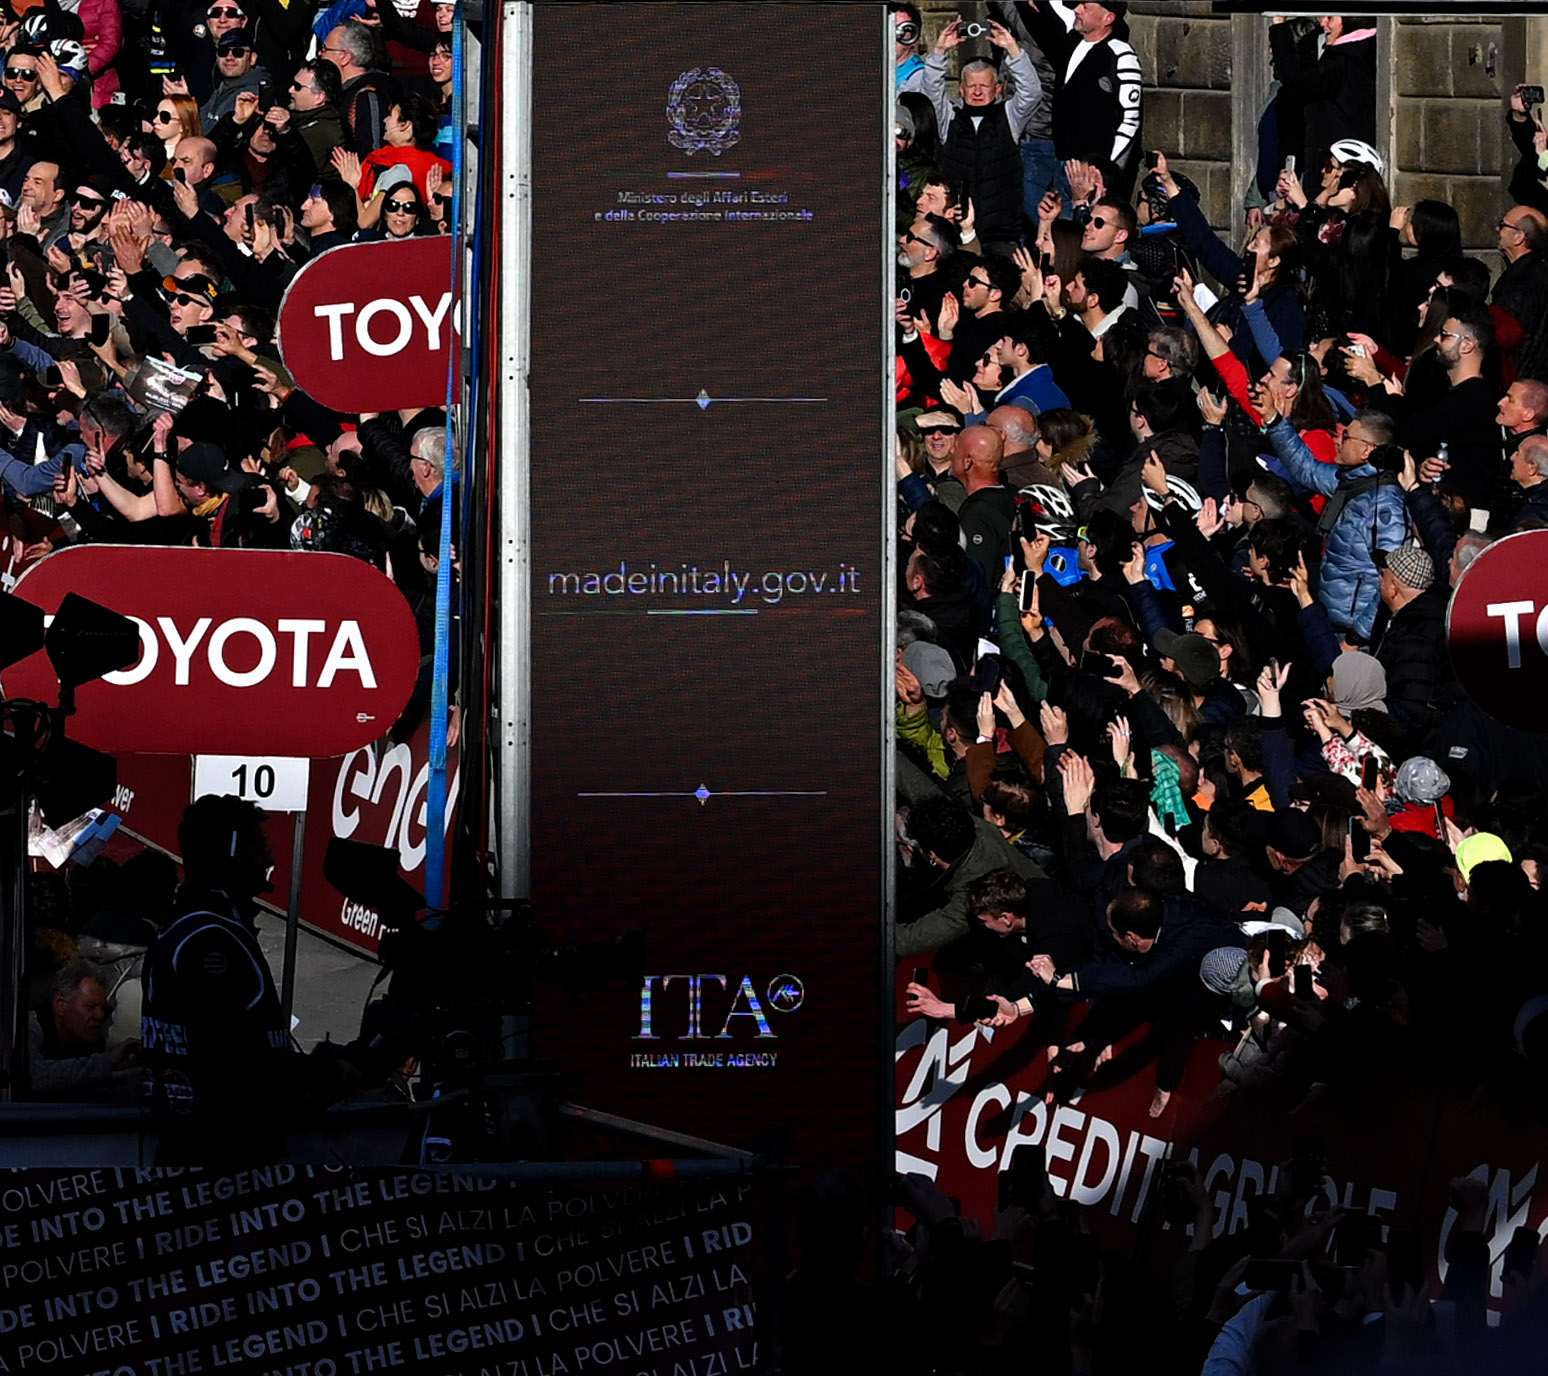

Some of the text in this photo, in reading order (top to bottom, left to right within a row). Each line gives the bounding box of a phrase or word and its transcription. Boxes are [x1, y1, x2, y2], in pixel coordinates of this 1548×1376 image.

[680, 191, 710, 206] degli
[314, 290, 461, 361] TOY
[547, 559, 862, 604] madeinitaly.gov.it
[54, 616, 378, 689] OYOTA
[230, 763, 276, 801] 10
[340, 896, 379, 938] Green
[630, 973, 779, 1040] ITA
[630, 1053, 778, 1068] ITALIAN TRADE AGENCY
[2, 1241, 128, 1288] POLVERE
[154, 1218, 222, 1256] RIDE
[230, 1198, 305, 1237] INTO
[312, 1181, 373, 1215] THE
[31, 1207, 105, 1243] INTO
[112, 1191, 174, 1224] THE
[181, 1162, 296, 1210] LEGEND
[17, 1320, 143, 1369] POLVERE
[169, 1297, 239, 1335] RIDE
[247, 1277, 321, 1315] INTO
[328, 1262, 389, 1295] THE
[397, 1243, 506, 1281] LEGEND
[534, 1228, 589, 1257] CHE
[44, 1286, 119, 1323] INTO
[127, 1268, 188, 1303] THE
[195, 1240, 312, 1289] LEGEND
[339, 1219, 401, 1253] CHE
[405, 1213, 429, 1240] SI
[438, 1209, 496, 1235] ALZI
[504, 1205, 537, 1230] LA
[144, 1348, 203, 1376] THE
[211, 1320, 328, 1368] LEGEND
[356, 1300, 417, 1332] CHE
[424, 1292, 450, 1319] SI
[459, 1280, 508, 1312] ALZI
[513, 1276, 547, 1300] LA
[557, 1240, 677, 1293] POLVERE
[344, 1341, 405, 1373] THE
[413, 1318, 525, 1360] LEGEND
[549, 1299, 607, 1332] CHE
[613, 1290, 639, 1317] SI
[651, 1273, 706, 1310] ALZI
[712, 1263, 749, 1292] LA
[574, 1319, 697, 1370] POLVERE
[722, 1302, 756, 1332] RI
